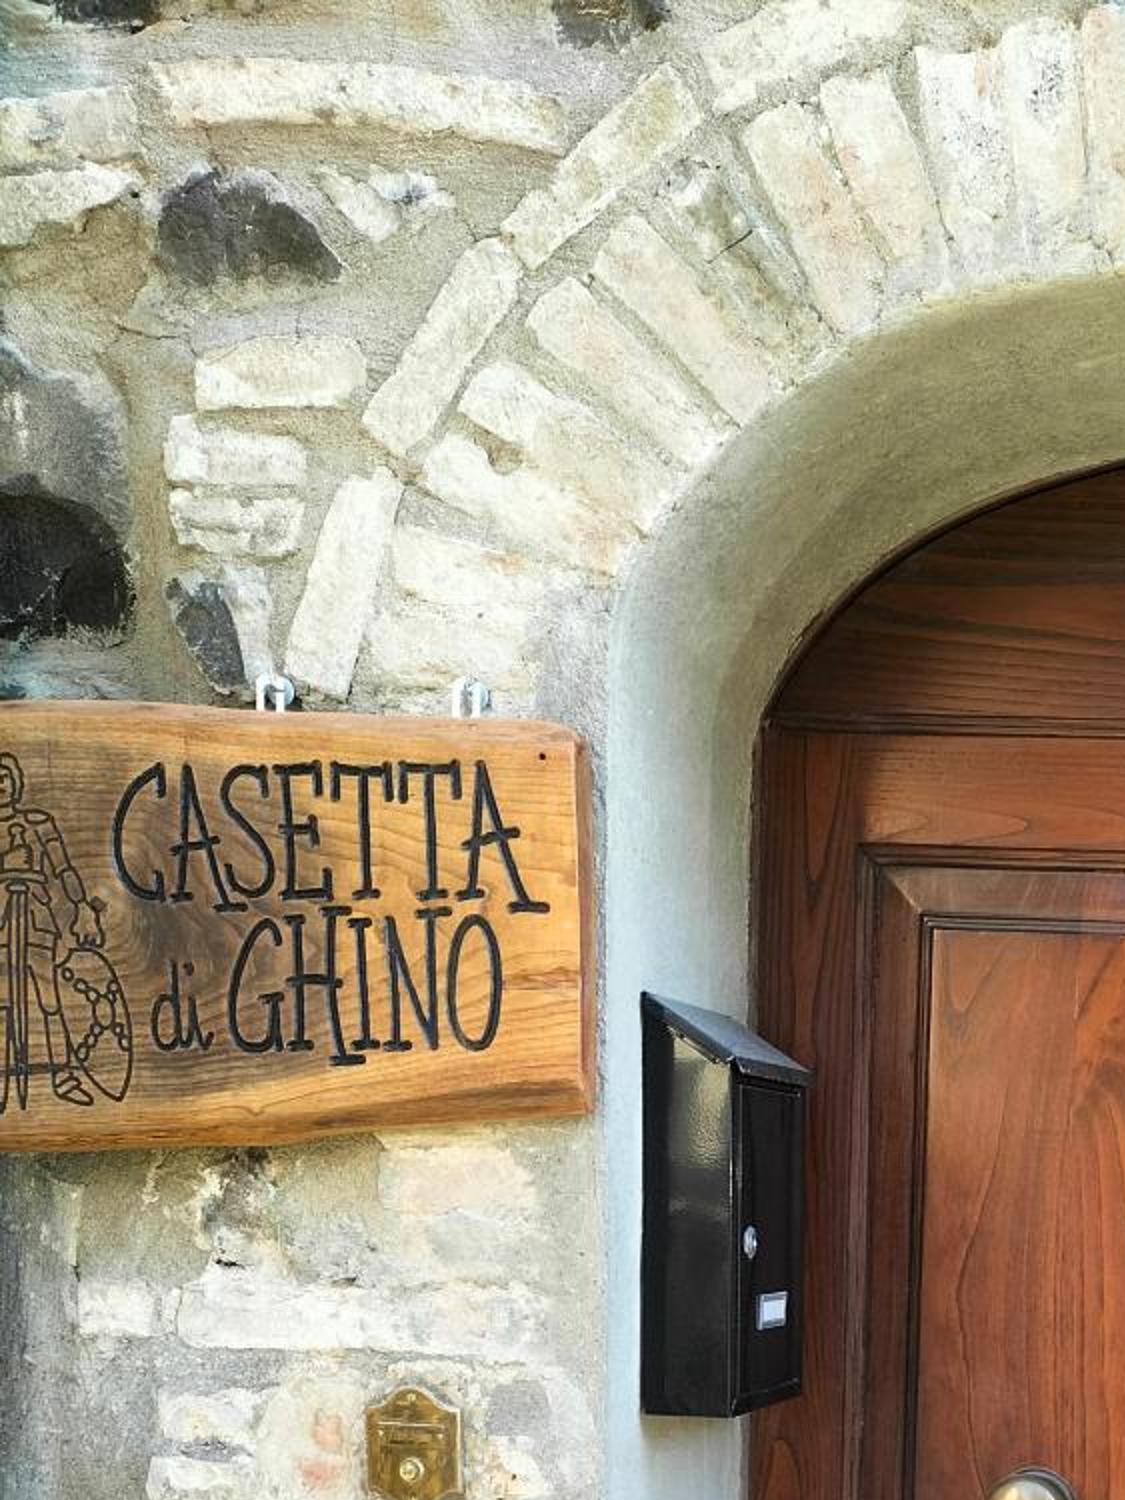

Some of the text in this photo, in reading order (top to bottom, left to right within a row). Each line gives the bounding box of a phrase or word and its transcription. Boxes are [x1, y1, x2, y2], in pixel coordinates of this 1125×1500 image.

[111, 759, 551, 913] CASETTA
[150, 904, 502, 1066] di GHINO
